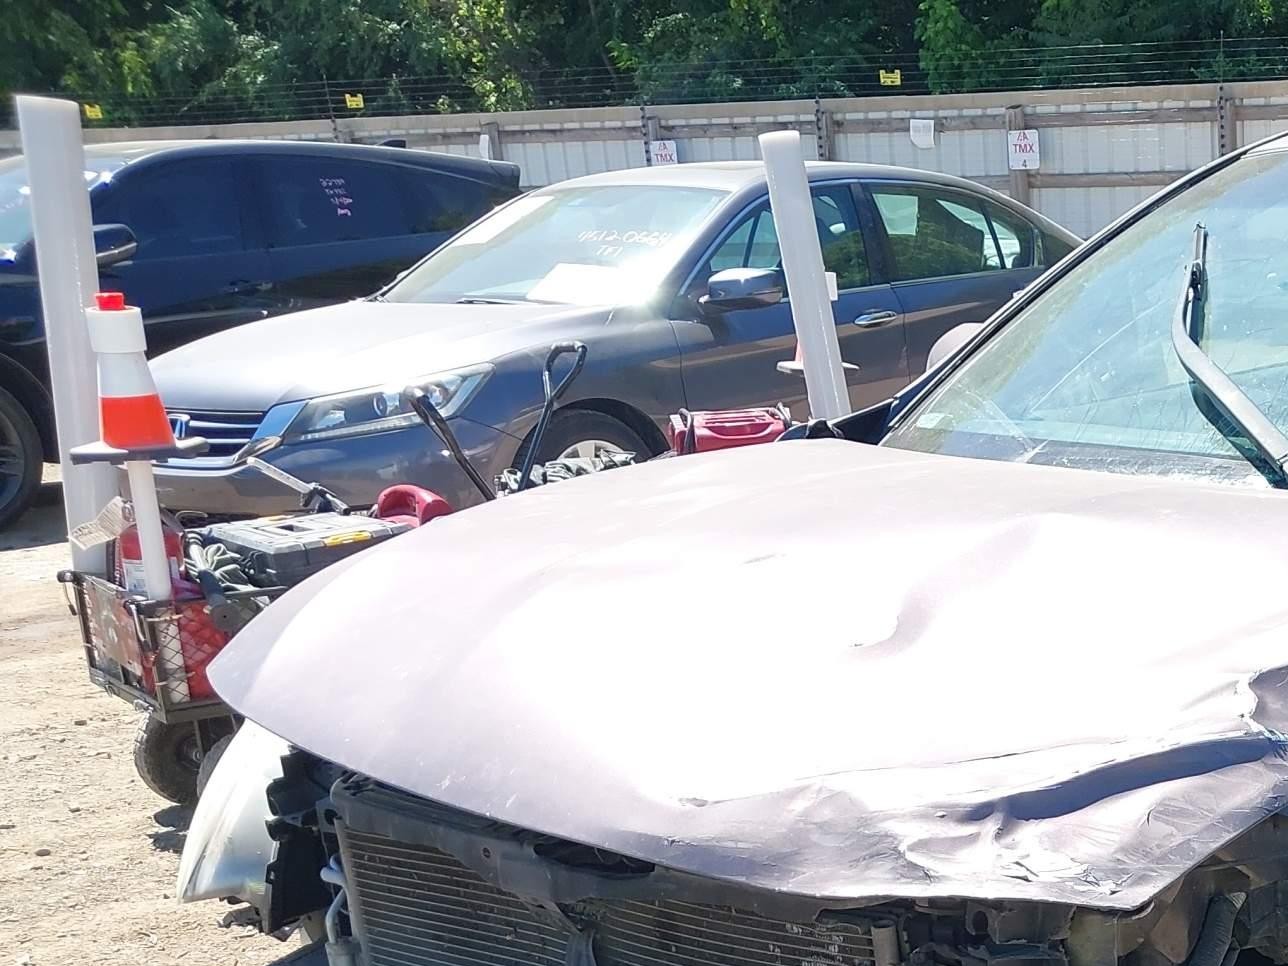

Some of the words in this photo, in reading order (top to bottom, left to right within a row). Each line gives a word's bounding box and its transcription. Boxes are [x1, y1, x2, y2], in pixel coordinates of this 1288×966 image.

[1012, 143, 1035, 153] TMX
[655, 153, 675, 163] TMX
[1021, 159, 1028, 168] 4
